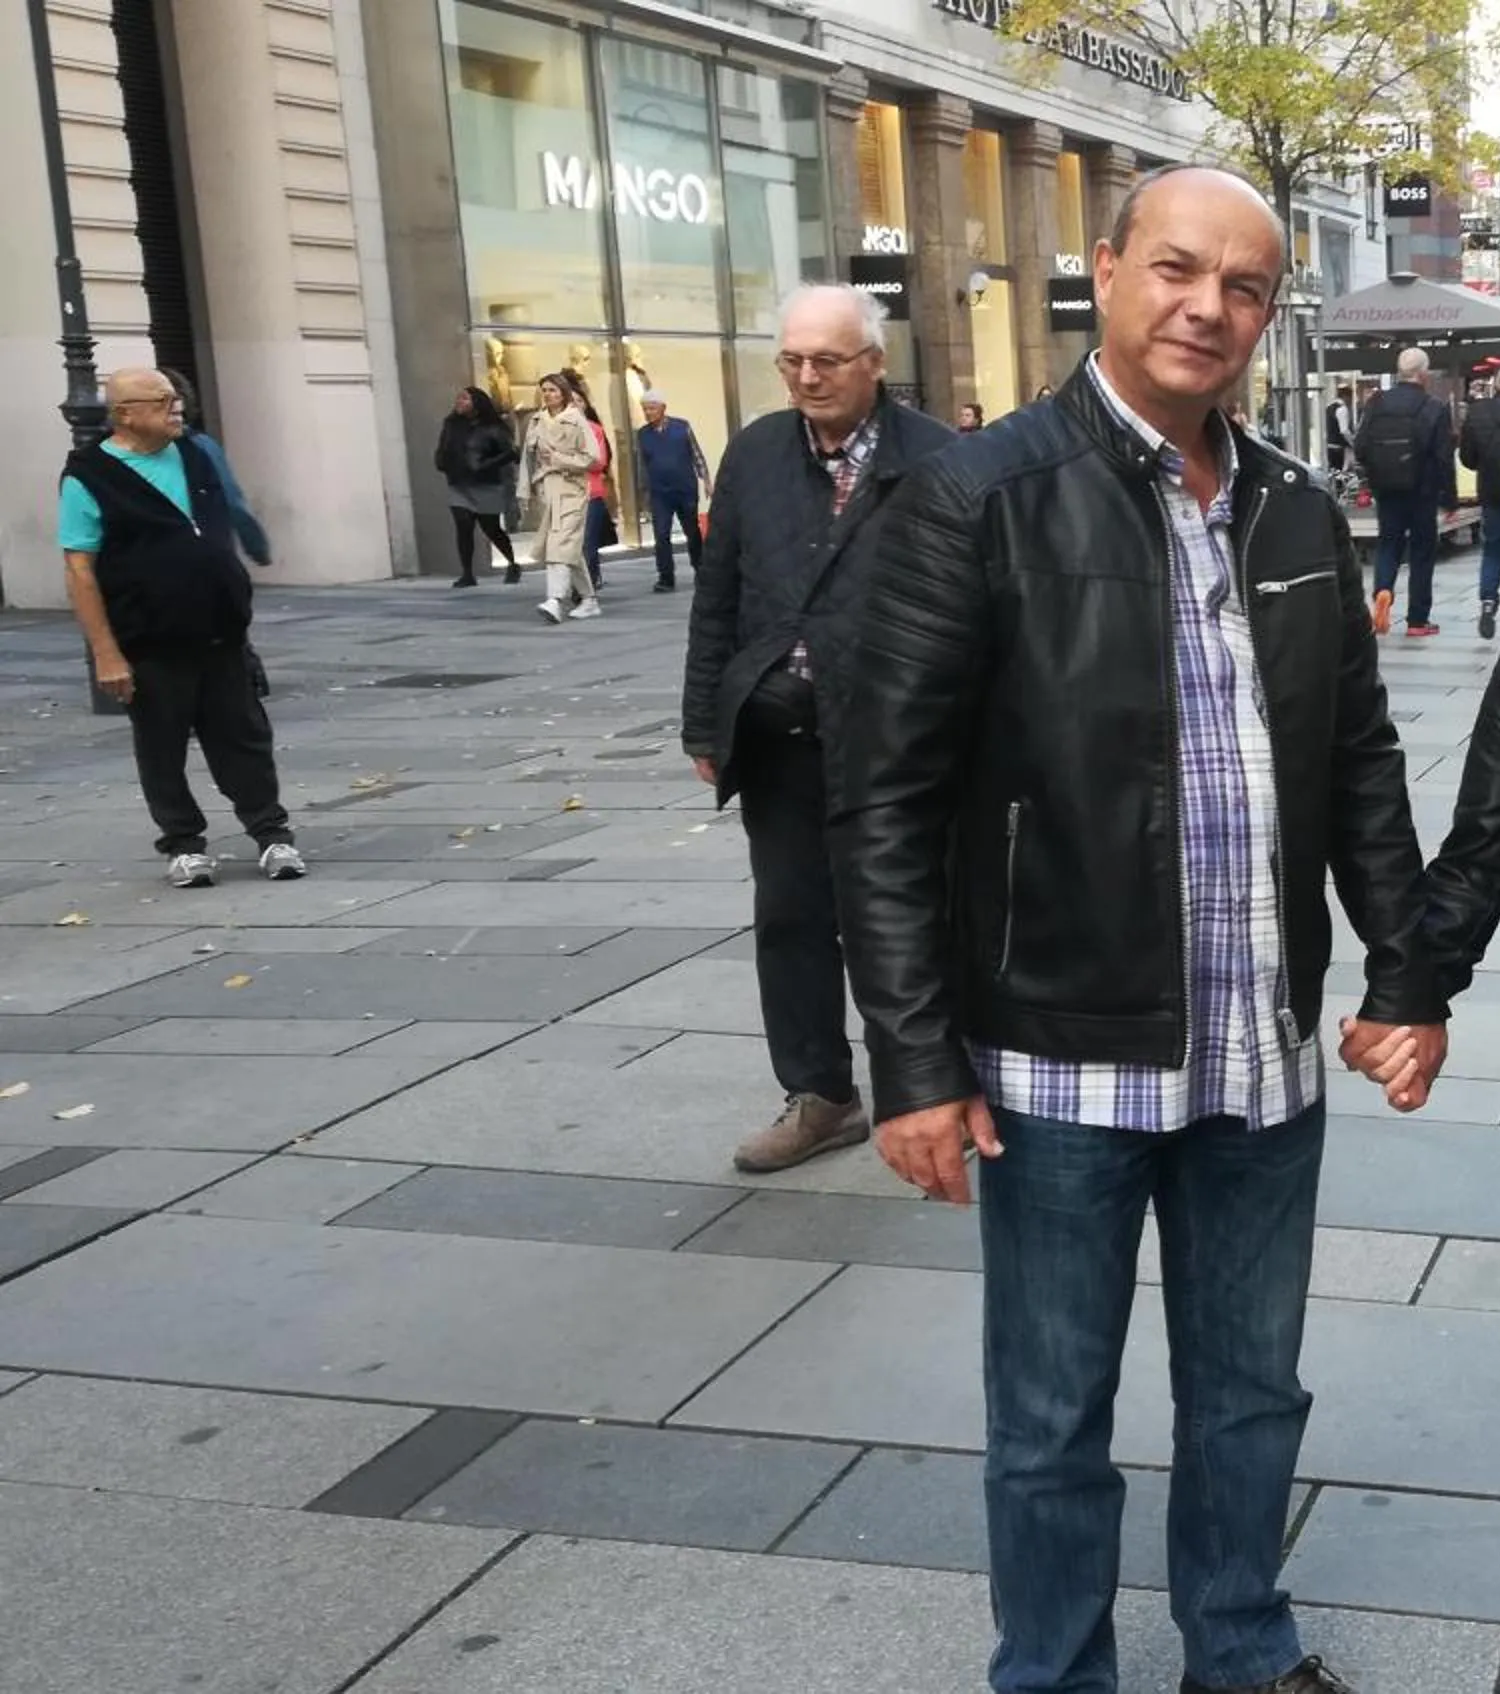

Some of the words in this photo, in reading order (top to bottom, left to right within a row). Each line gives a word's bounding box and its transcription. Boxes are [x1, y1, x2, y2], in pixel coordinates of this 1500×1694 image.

[1390, 187, 1428, 200] BOSS
[862, 224, 909, 254] NGO
[1333, 304, 1464, 321] Ambassador
